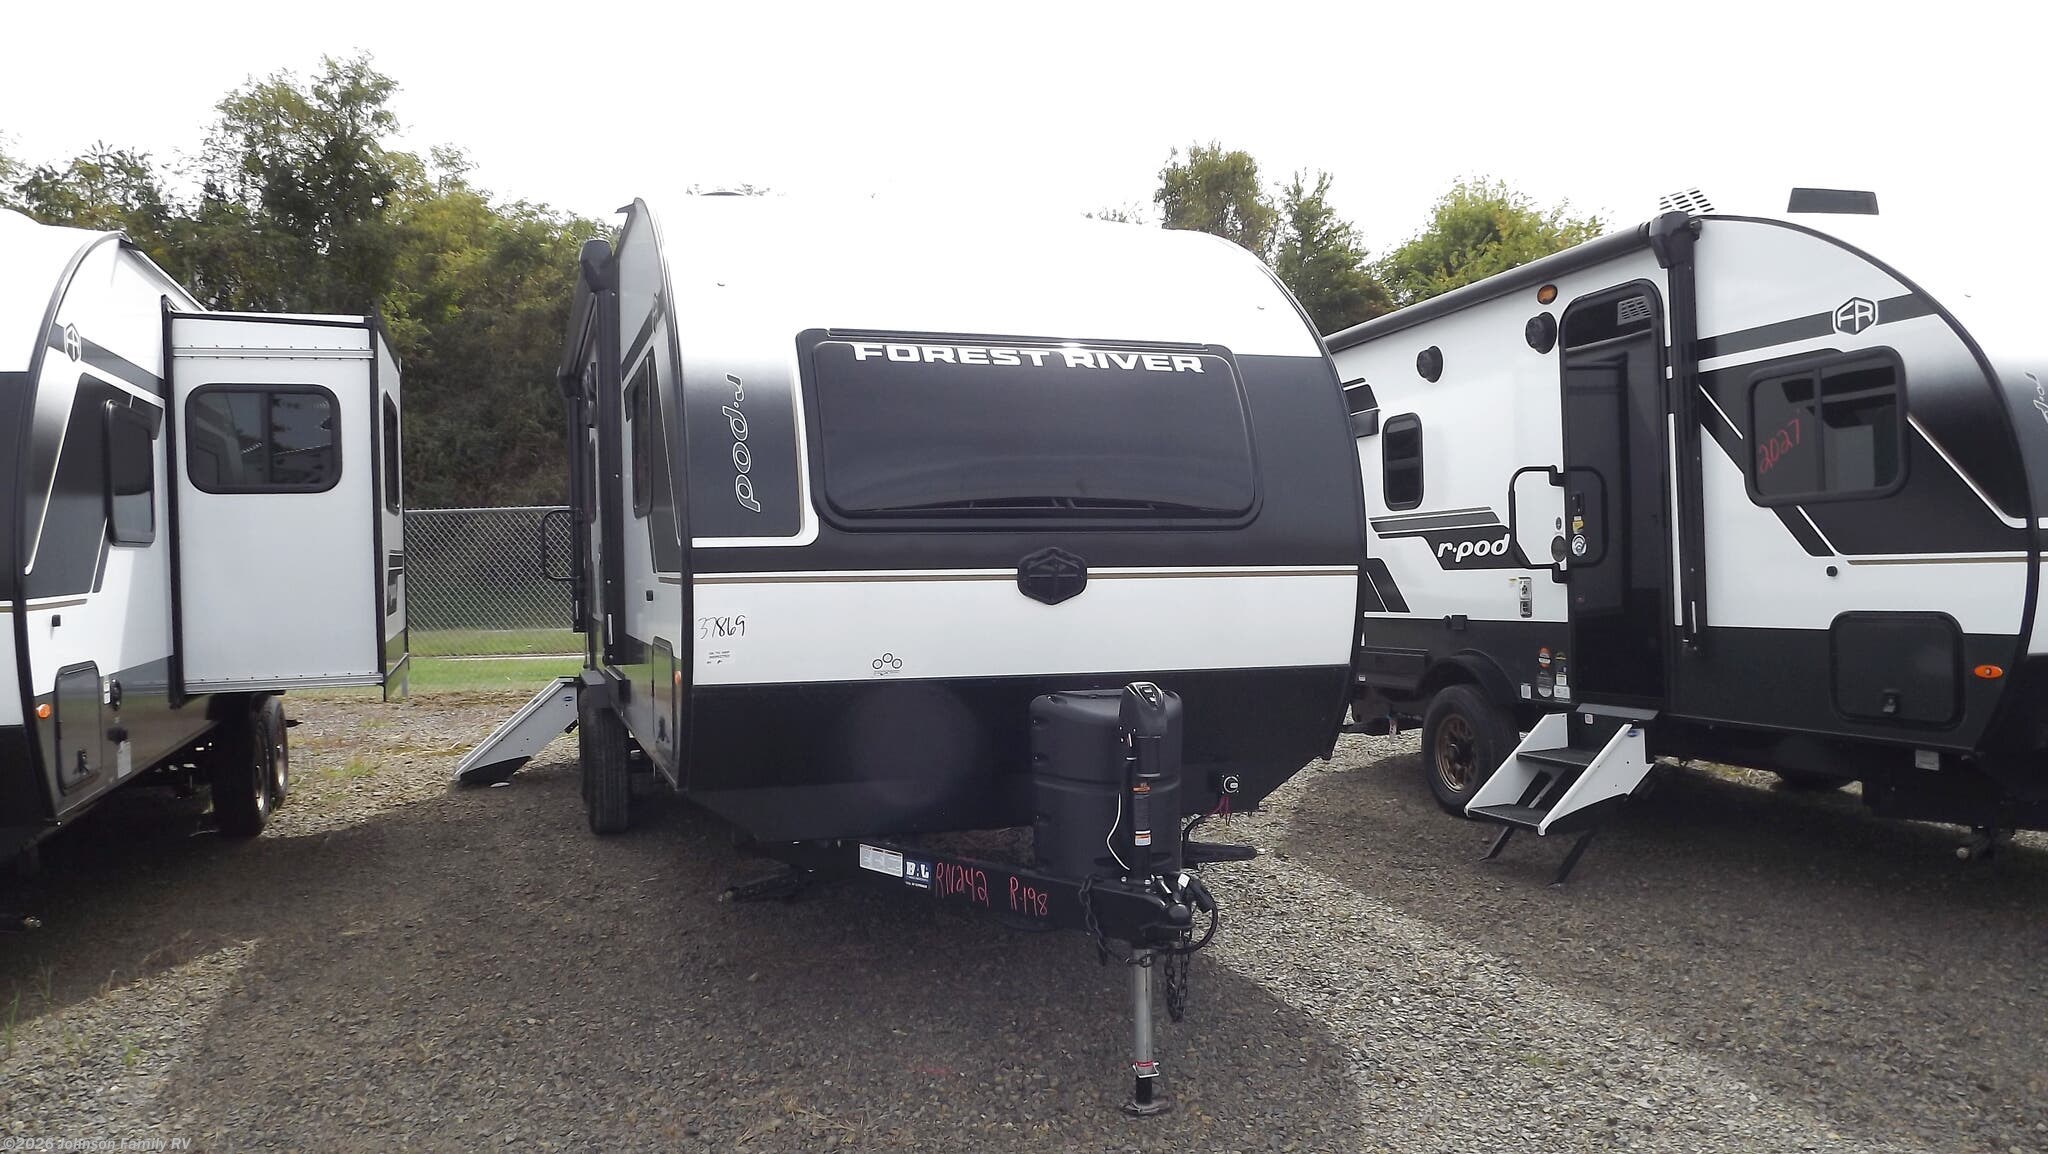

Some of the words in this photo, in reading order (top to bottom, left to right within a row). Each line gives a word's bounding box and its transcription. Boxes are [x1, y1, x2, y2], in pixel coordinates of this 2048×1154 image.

[850, 342, 1050, 368] FOREST
[1059, 351, 1205, 374] RIVER
[1759, 418, 1800, 473] 2027
[698, 614, 746, 639] 37869
